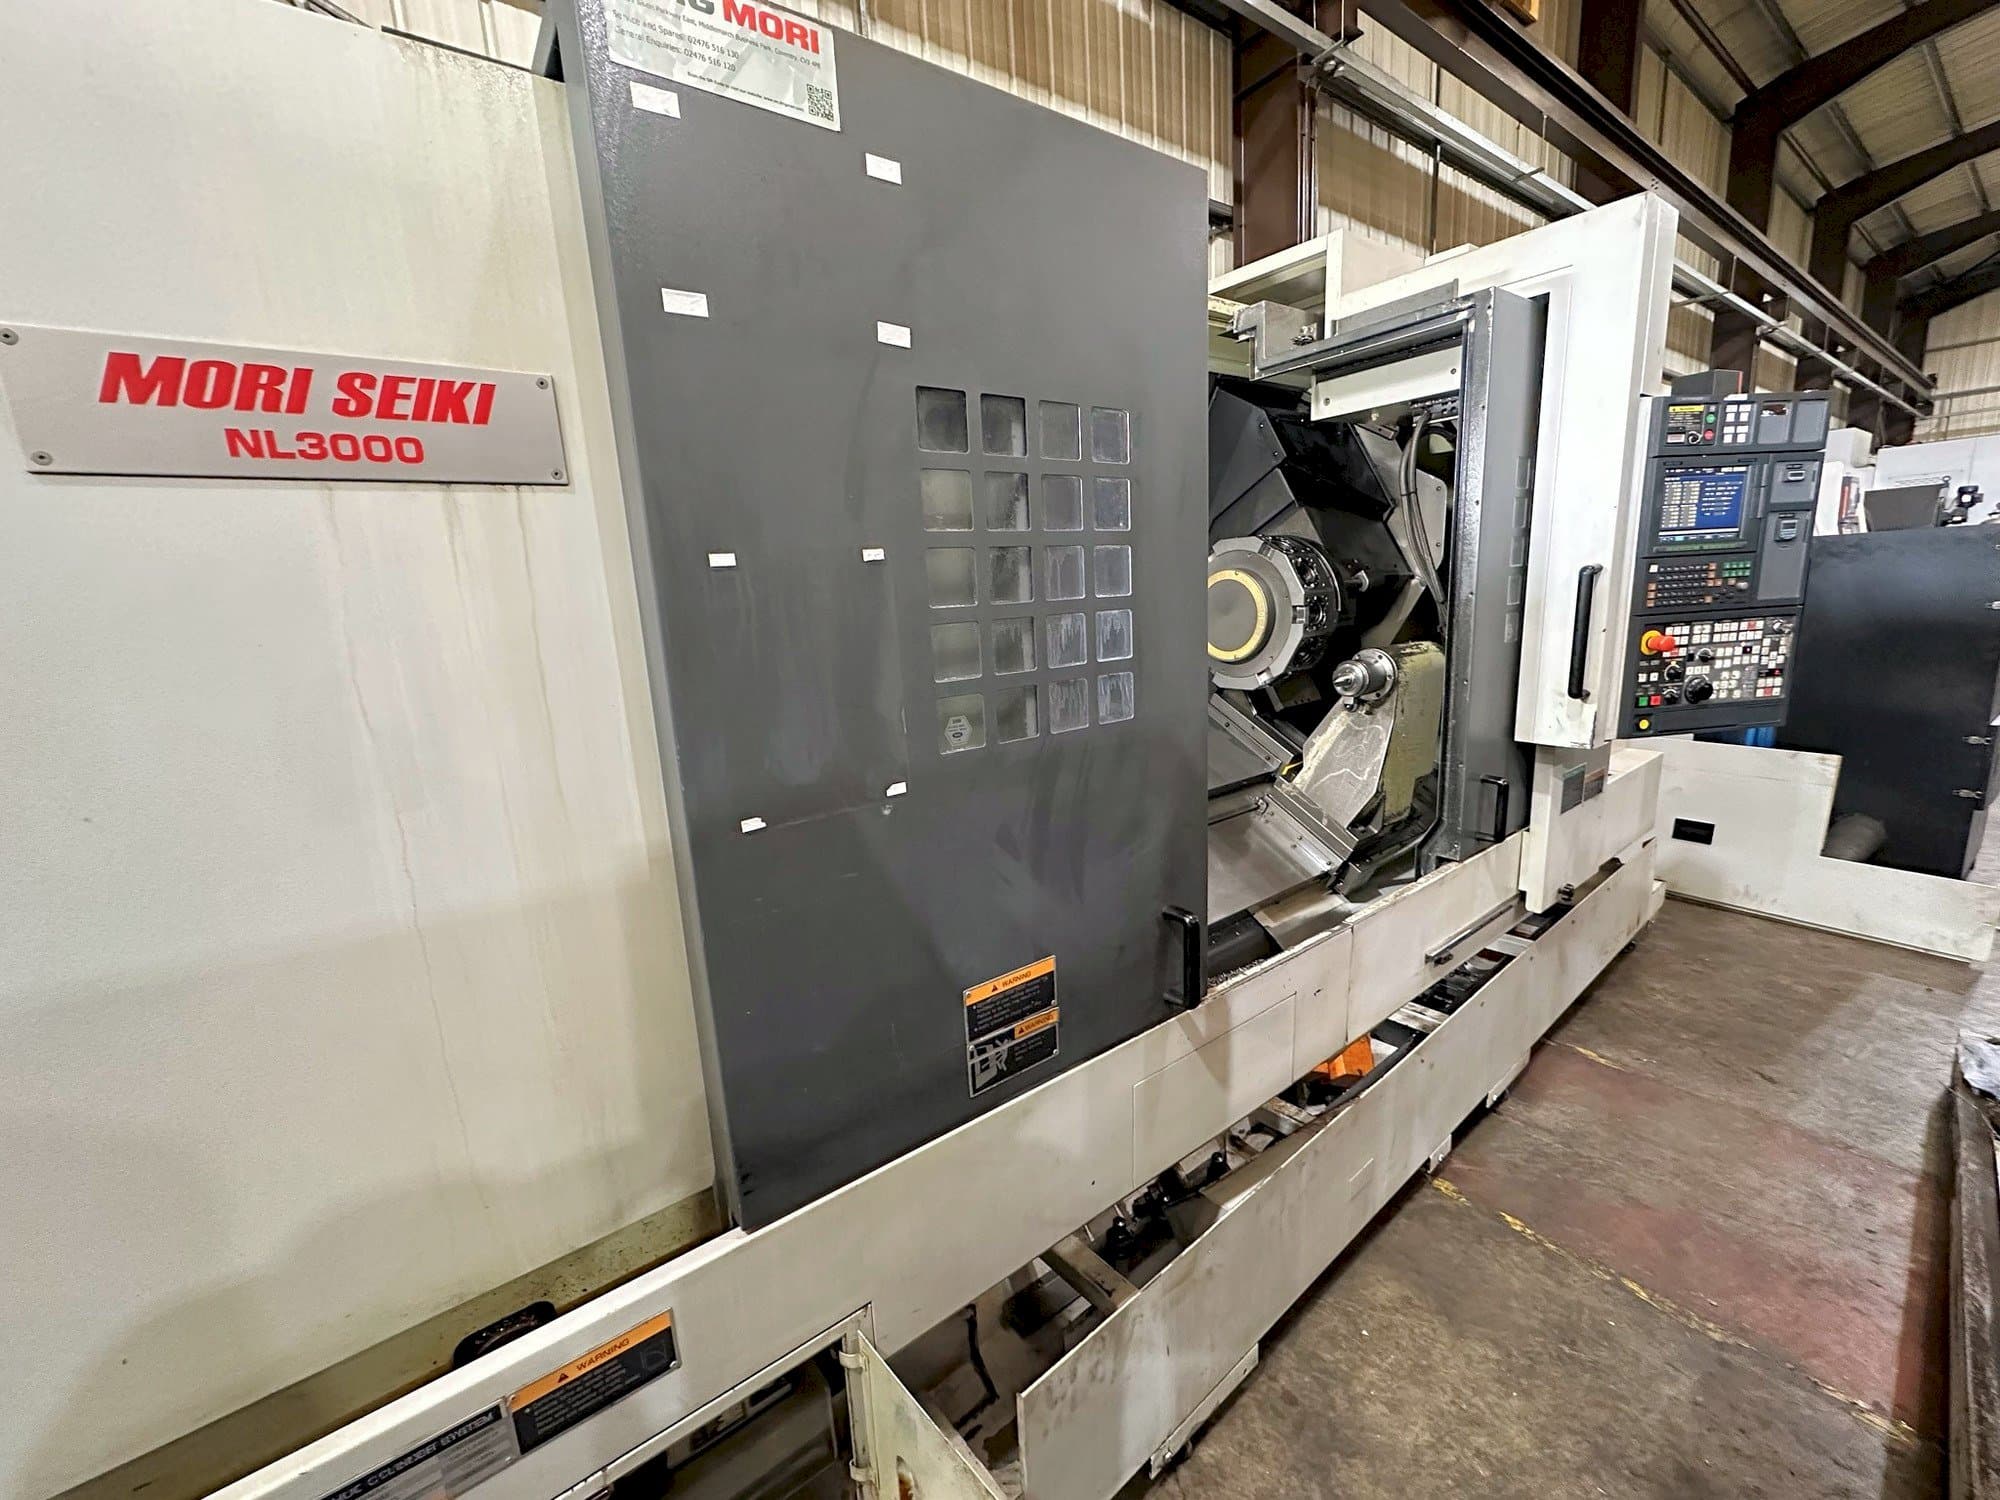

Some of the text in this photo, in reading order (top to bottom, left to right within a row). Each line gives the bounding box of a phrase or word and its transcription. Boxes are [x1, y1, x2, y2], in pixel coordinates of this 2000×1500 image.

[722, 0, 820, 54] MORI
[684, 48, 706, 62] 02476
[708, 57, 721, 68] 516
[687, 35, 710, 50] 02476
[711, 44, 725, 55] 516
[98, 351, 496, 425] MORI SEIKI
[225, 429, 424, 464] NL3000
[1002, 970, 1032, 988] WARNING
[575, 1338, 631, 1372] WARNING
